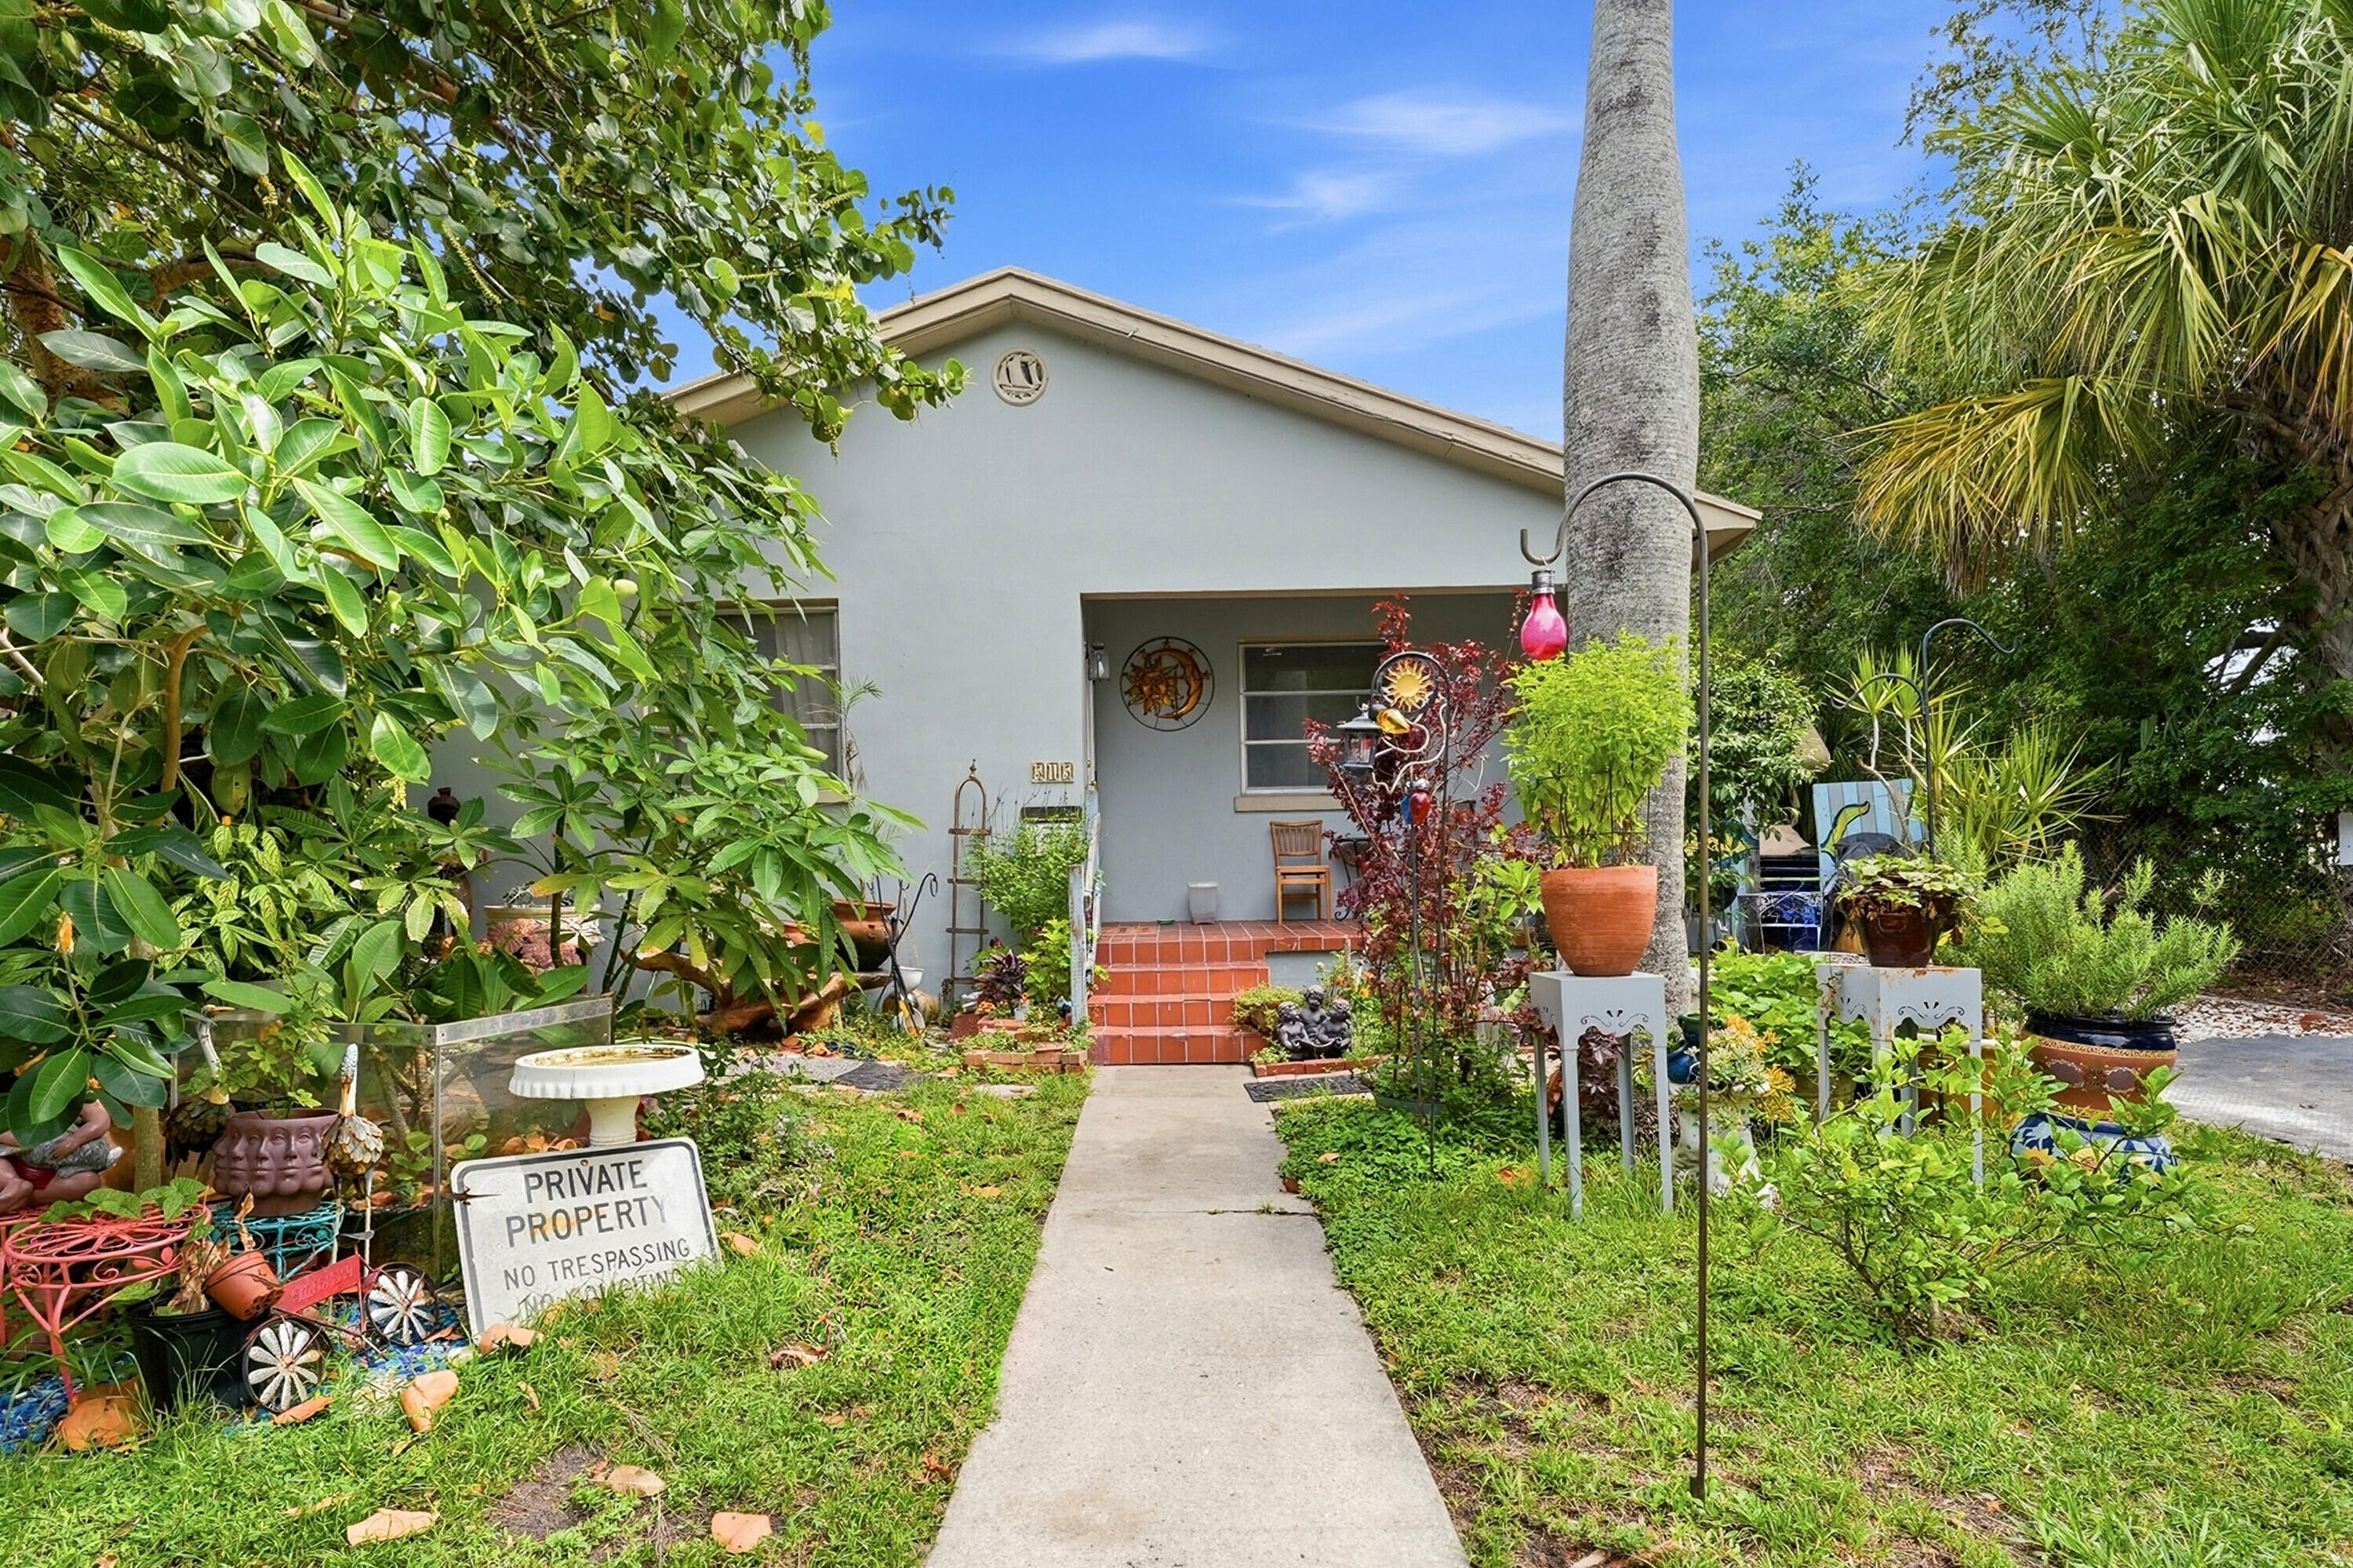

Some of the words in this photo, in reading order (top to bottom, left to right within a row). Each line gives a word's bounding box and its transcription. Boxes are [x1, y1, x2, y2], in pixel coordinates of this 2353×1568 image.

[524, 1159, 648, 1204] PRIVATE
[505, 1195, 667, 1248] PROPERTY
[503, 1264, 536, 1290] NO
[547, 1238, 691, 1282] TRESPASSING
